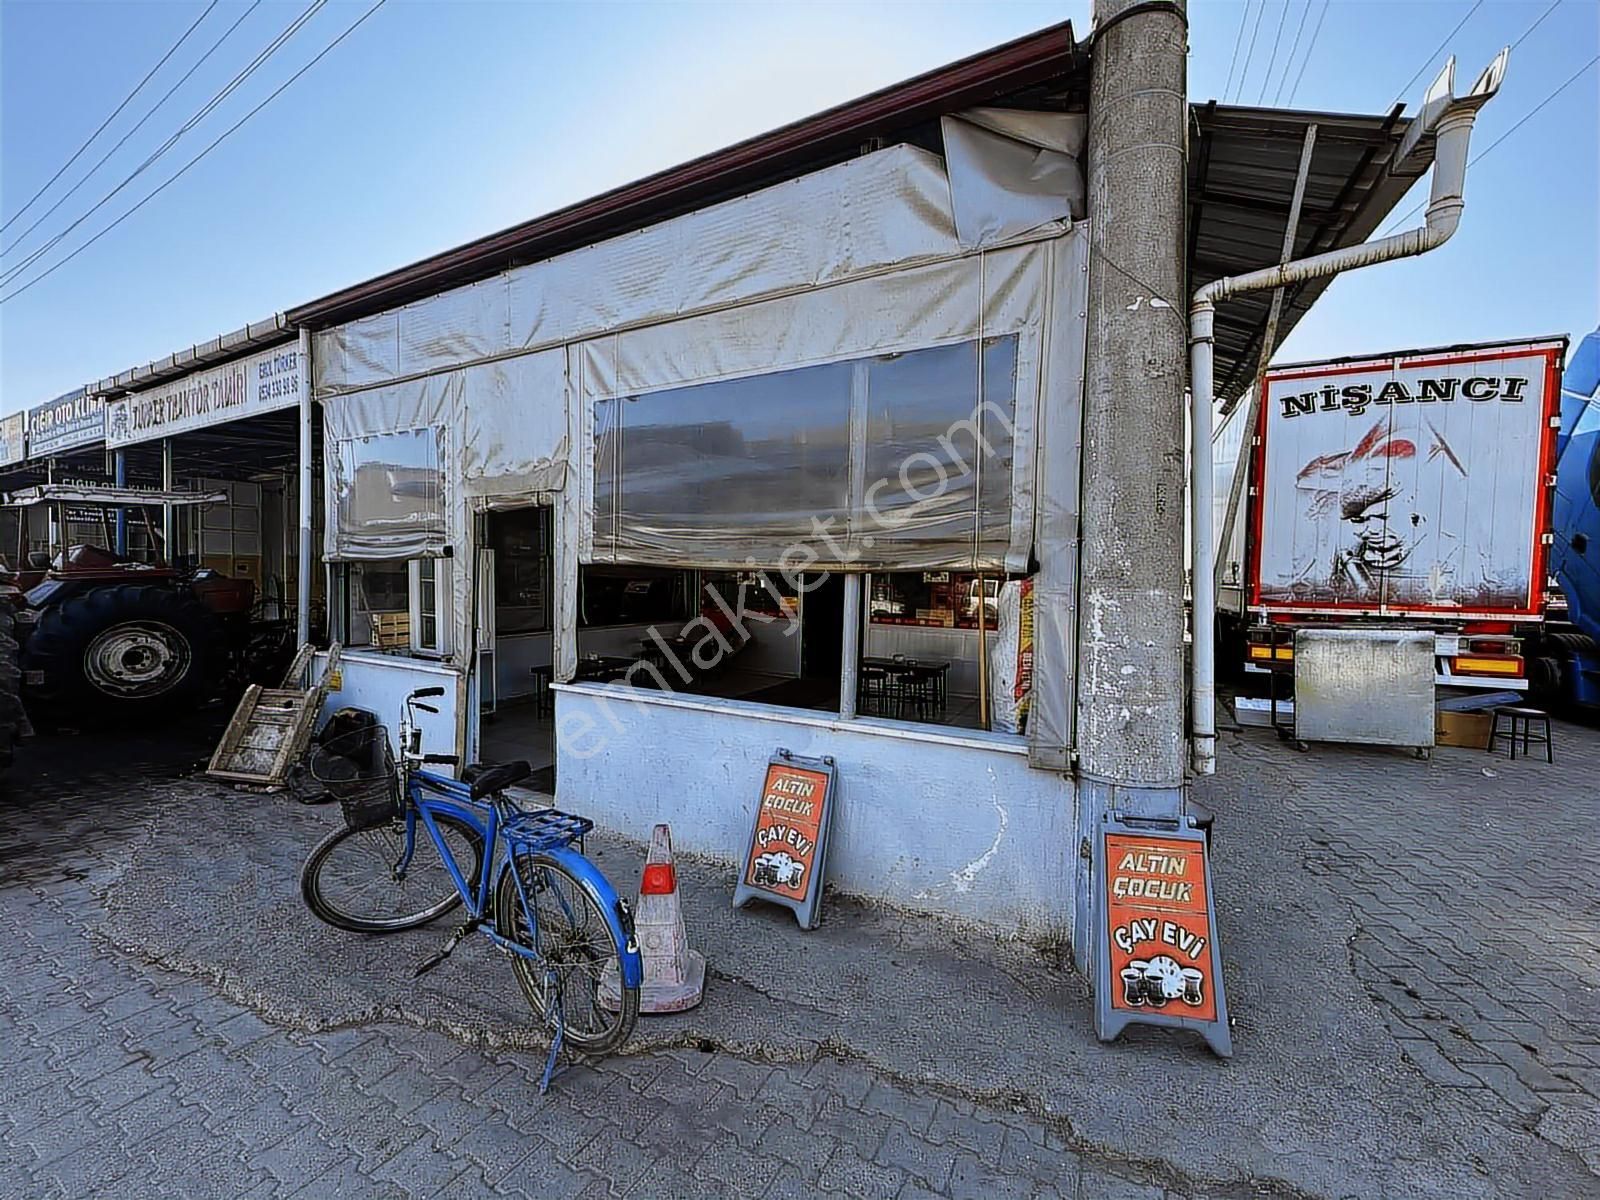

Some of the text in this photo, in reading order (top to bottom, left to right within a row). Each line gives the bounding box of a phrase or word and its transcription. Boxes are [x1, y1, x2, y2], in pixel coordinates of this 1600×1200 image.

[55, 402, 73, 425] OTO
[74, 394, 105, 418] KLİMA
[1280, 377, 1528, 418] NİŞANCI
[772, 778, 814, 797] ALTIN
[757, 825, 814, 857] ÇAY EVİ
[1118, 853, 1187, 875] ALTIN
[1112, 876, 1194, 903] ÇOCUK
[1114, 918, 1207, 960] ÇAY EVİ
